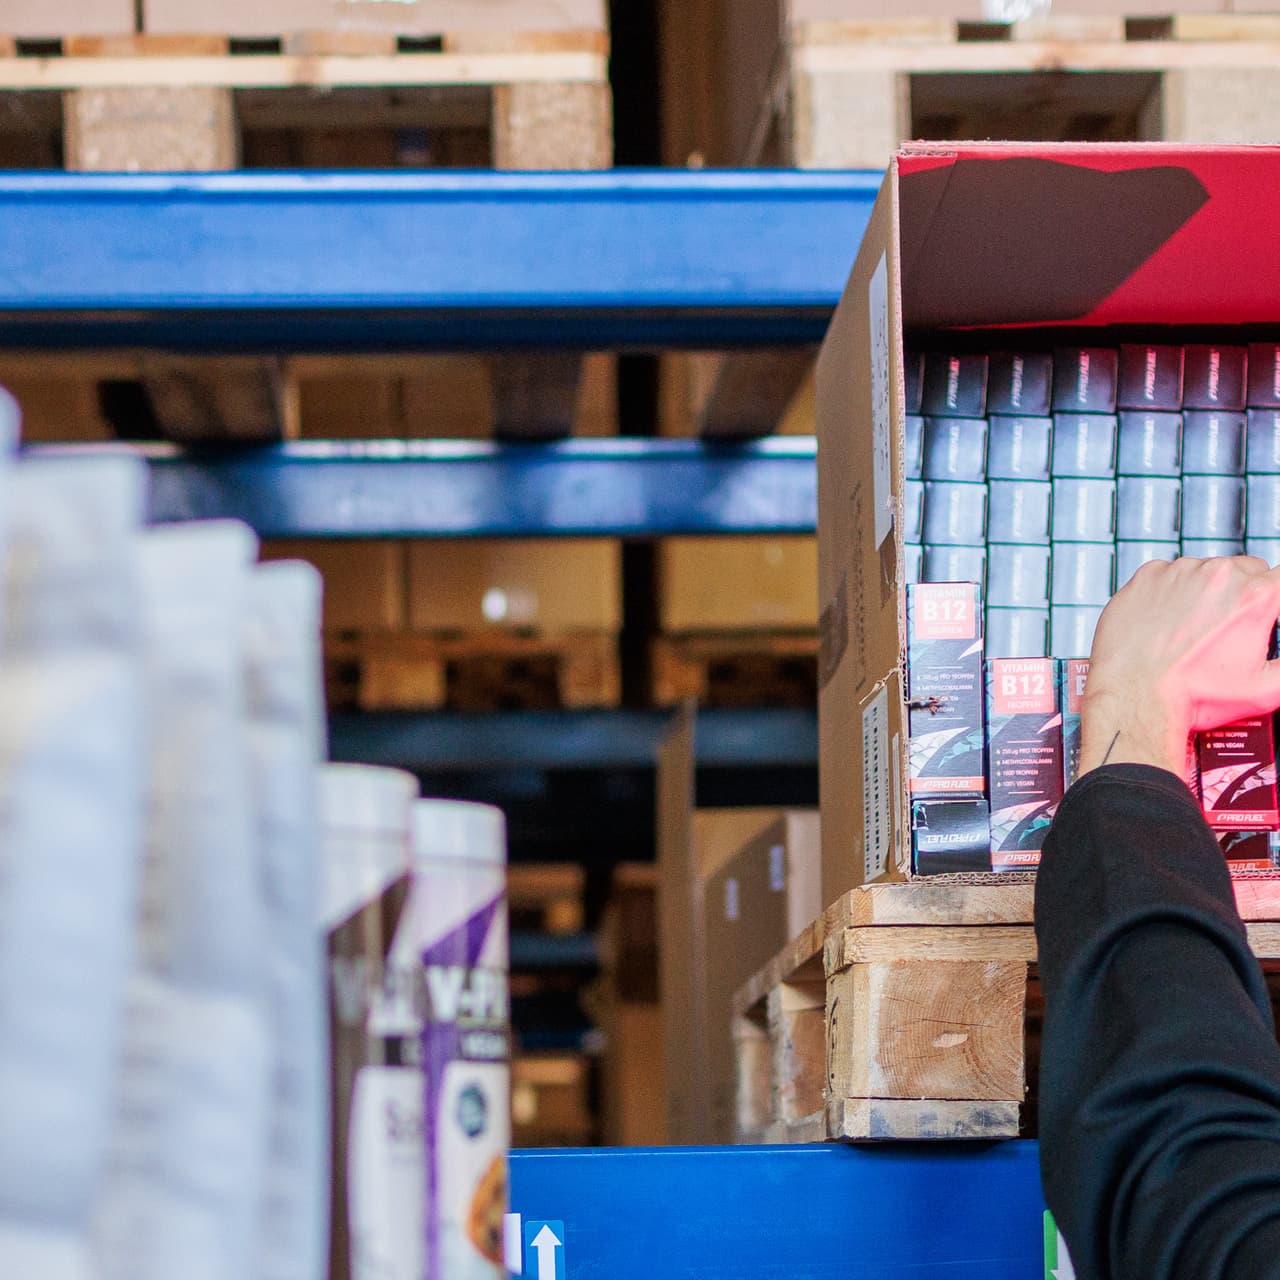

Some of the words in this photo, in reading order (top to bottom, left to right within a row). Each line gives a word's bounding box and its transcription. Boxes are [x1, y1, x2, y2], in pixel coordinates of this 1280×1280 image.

[923, 601, 967, 621] B12
[1001, 663, 1045, 673] VITAMIN
[1001, 675, 1045, 695] B12
